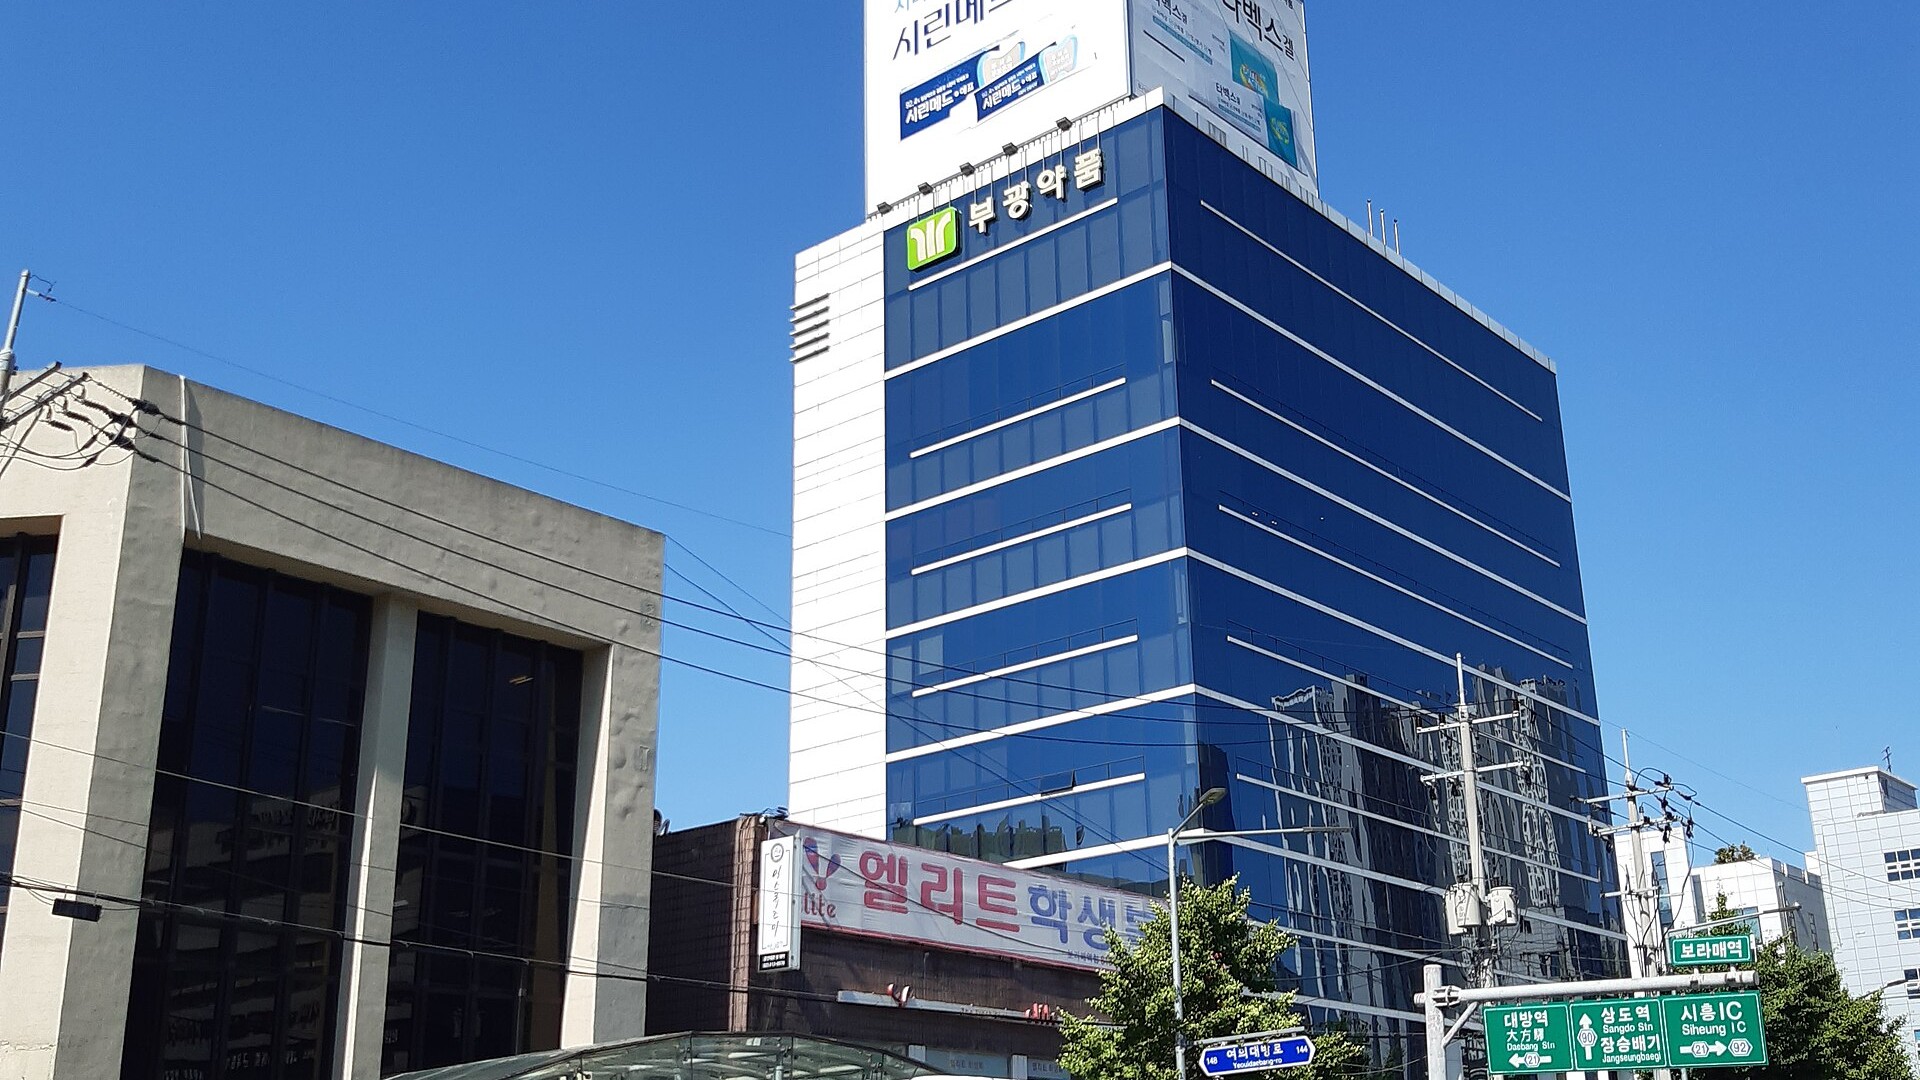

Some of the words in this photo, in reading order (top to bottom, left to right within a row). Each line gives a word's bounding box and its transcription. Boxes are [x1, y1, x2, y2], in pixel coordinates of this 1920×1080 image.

[905, 89, 955, 124] 시린메드
[969, 148, 1103, 234] 부광약품
[859, 851, 1020, 933] 엘리트
[1680, 940, 1742, 958] 보라매역
[1503, 1010, 1549, 1029] 대방역
[1600, 1005, 1651, 1024] 상도역
[1603, 1023, 1635, 1035] Sangdo
[1637, 1021, 1654, 1033] Stn
[1682, 1022, 1727, 1038] Siheung
[1506, 1042, 1540, 1052] Daebang
[1542, 1040, 1556, 1050] Stn
[1580, 1031, 1594, 1045] 90
[1600, 1033, 1662, 1055] 장승배기
[1226, 1042, 1284, 1061] 여의대방로
[1694, 1042, 1708, 1056] 21
[1733, 1039, 1748, 1054] 92
[1232, 1057, 1283, 1070] Yeouidaebang-ro
[1527, 1055, 1540, 1065] 21
[1601, 1051, 1663, 1065] Jangseungbaegi
